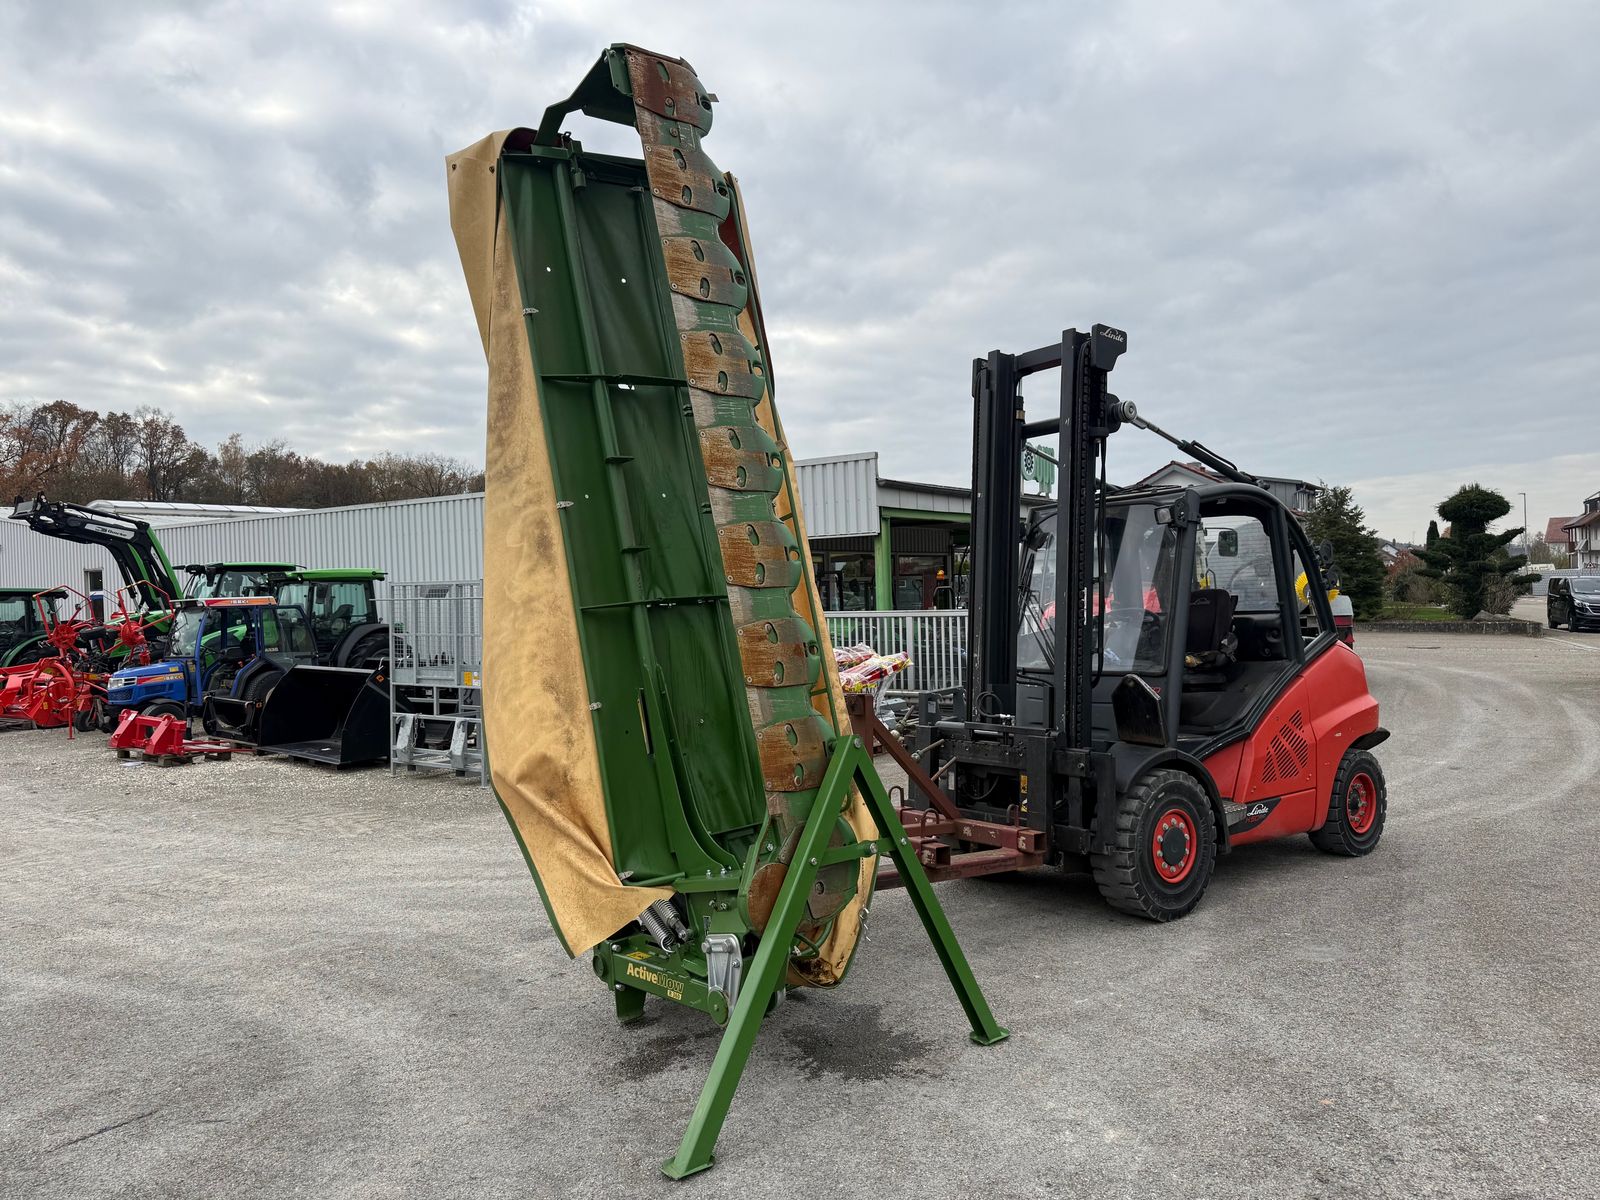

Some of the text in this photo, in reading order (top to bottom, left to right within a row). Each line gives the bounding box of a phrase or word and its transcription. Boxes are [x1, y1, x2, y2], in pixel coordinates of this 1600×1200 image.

[1100, 327, 1124, 343] Linde
[1247, 803, 1269, 816] Linde
[626, 961, 685, 994] ActiveMow
